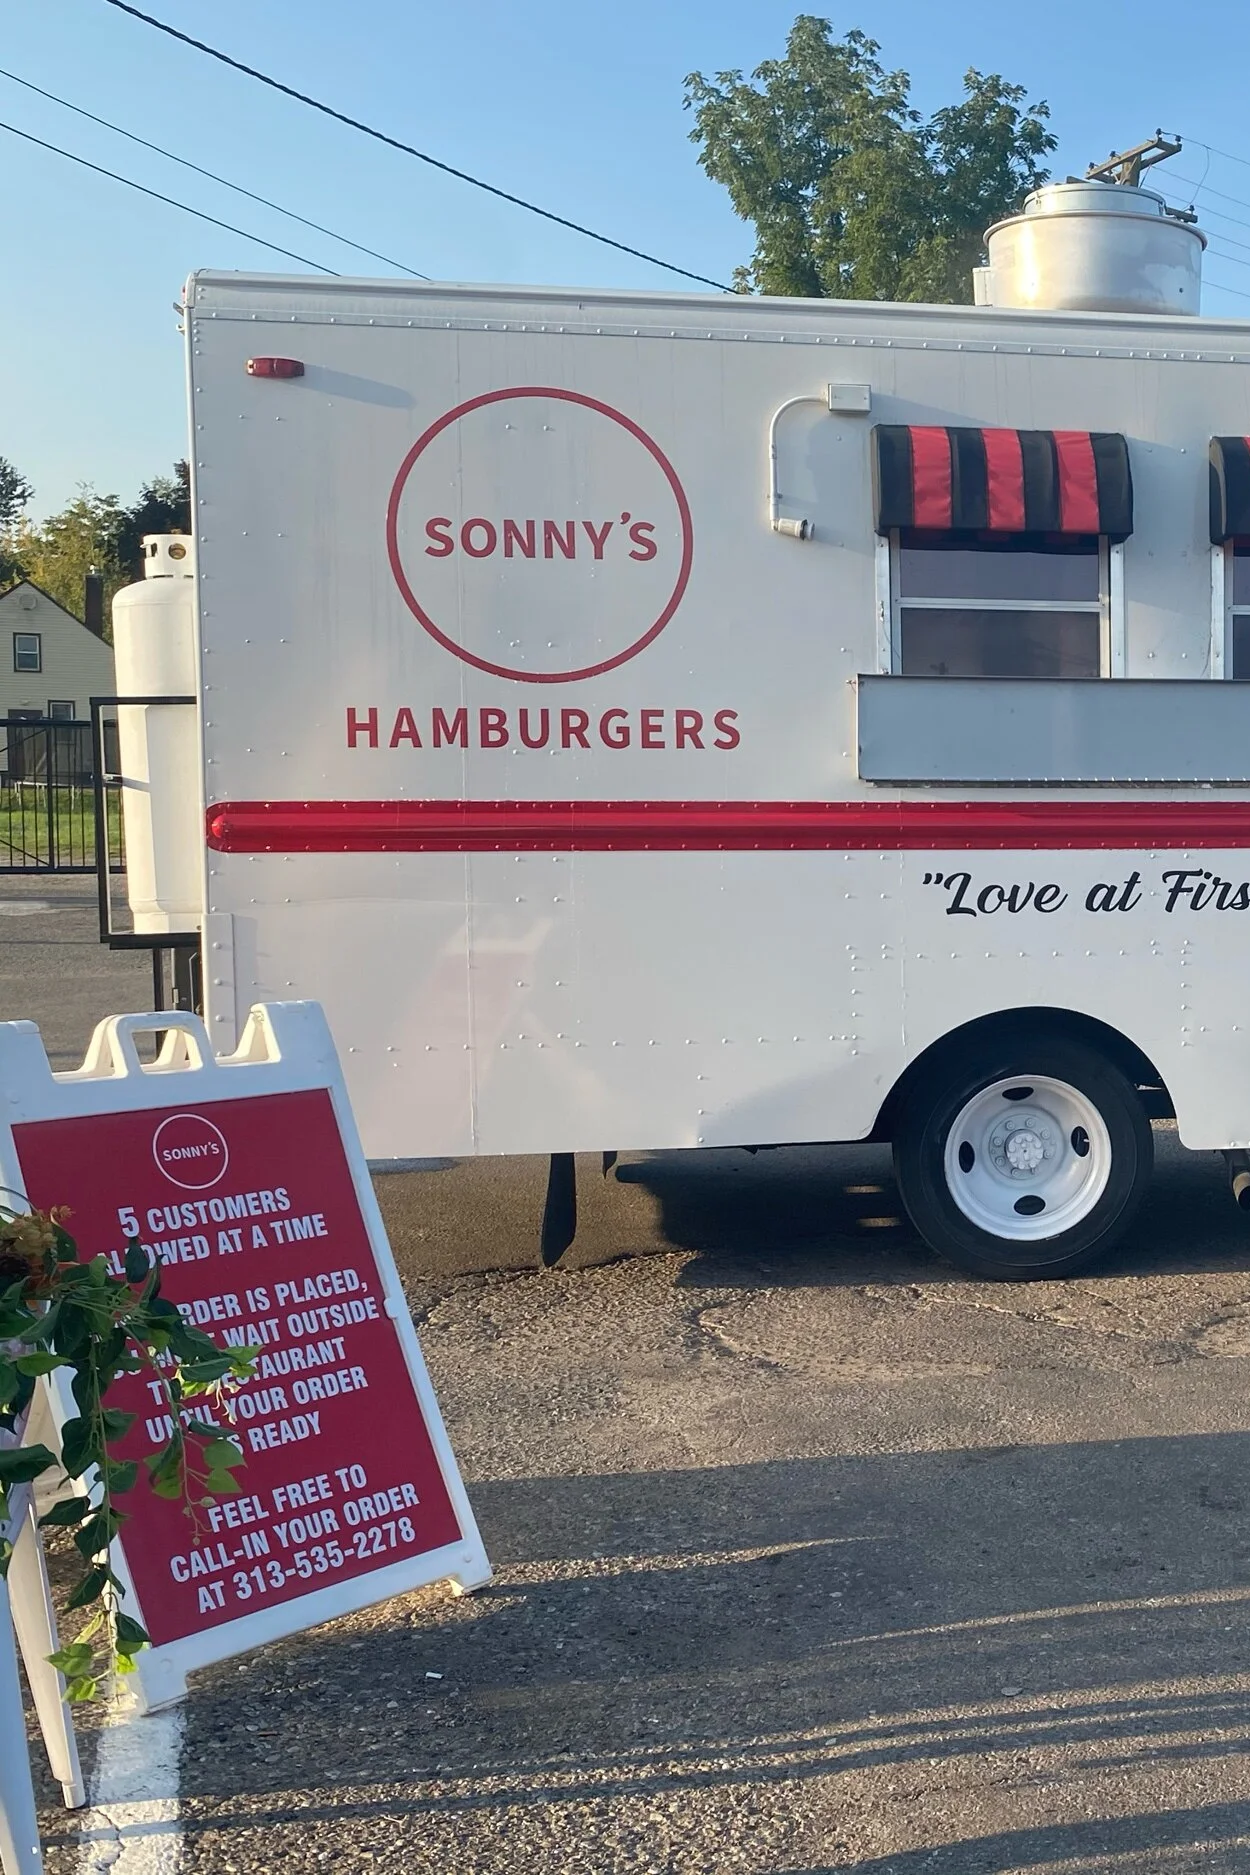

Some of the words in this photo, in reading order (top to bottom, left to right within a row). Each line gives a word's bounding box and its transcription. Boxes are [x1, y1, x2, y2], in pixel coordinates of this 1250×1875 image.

[424, 511, 657, 561] SONNY'S
[345, 706, 741, 750] HAMBURGERS
[922, 871, 1068, 918] "Love
[1085, 871, 1144, 913] at
[162, 1141, 220, 1162] SONNY'S
[118, 1206, 140, 1237] 5
[146, 1187, 291, 1233] CUSTOMERS
[216, 1228, 244, 1255] AT
[251, 1224, 268, 1249] A
[269, 1213, 329, 1244] TIME
[175, 1294, 242, 1326] RDER
[245, 1286, 270, 1314] IS
[274, 1268, 368, 1306] PLACED,
[222, 1318, 280, 1348] WAIT
[287, 1297, 380, 1338] OUTSIDE
[226, 1386, 289, 1421] YOUR
[292, 1365, 369, 1405] ORDER
[248, 1410, 321, 1453] READY
[207, 1495, 269, 1533] FEEL
[272, 1473, 334, 1513] FREE
[335, 1463, 367, 1493] TO
[170, 1530, 271, 1583] CALL-IN
[273, 1508, 340, 1548] YOUR
[343, 1482, 420, 1526] ORDER
[198, 1580, 227, 1614] AT
[233, 1516, 416, 1601] 313-535-2278
